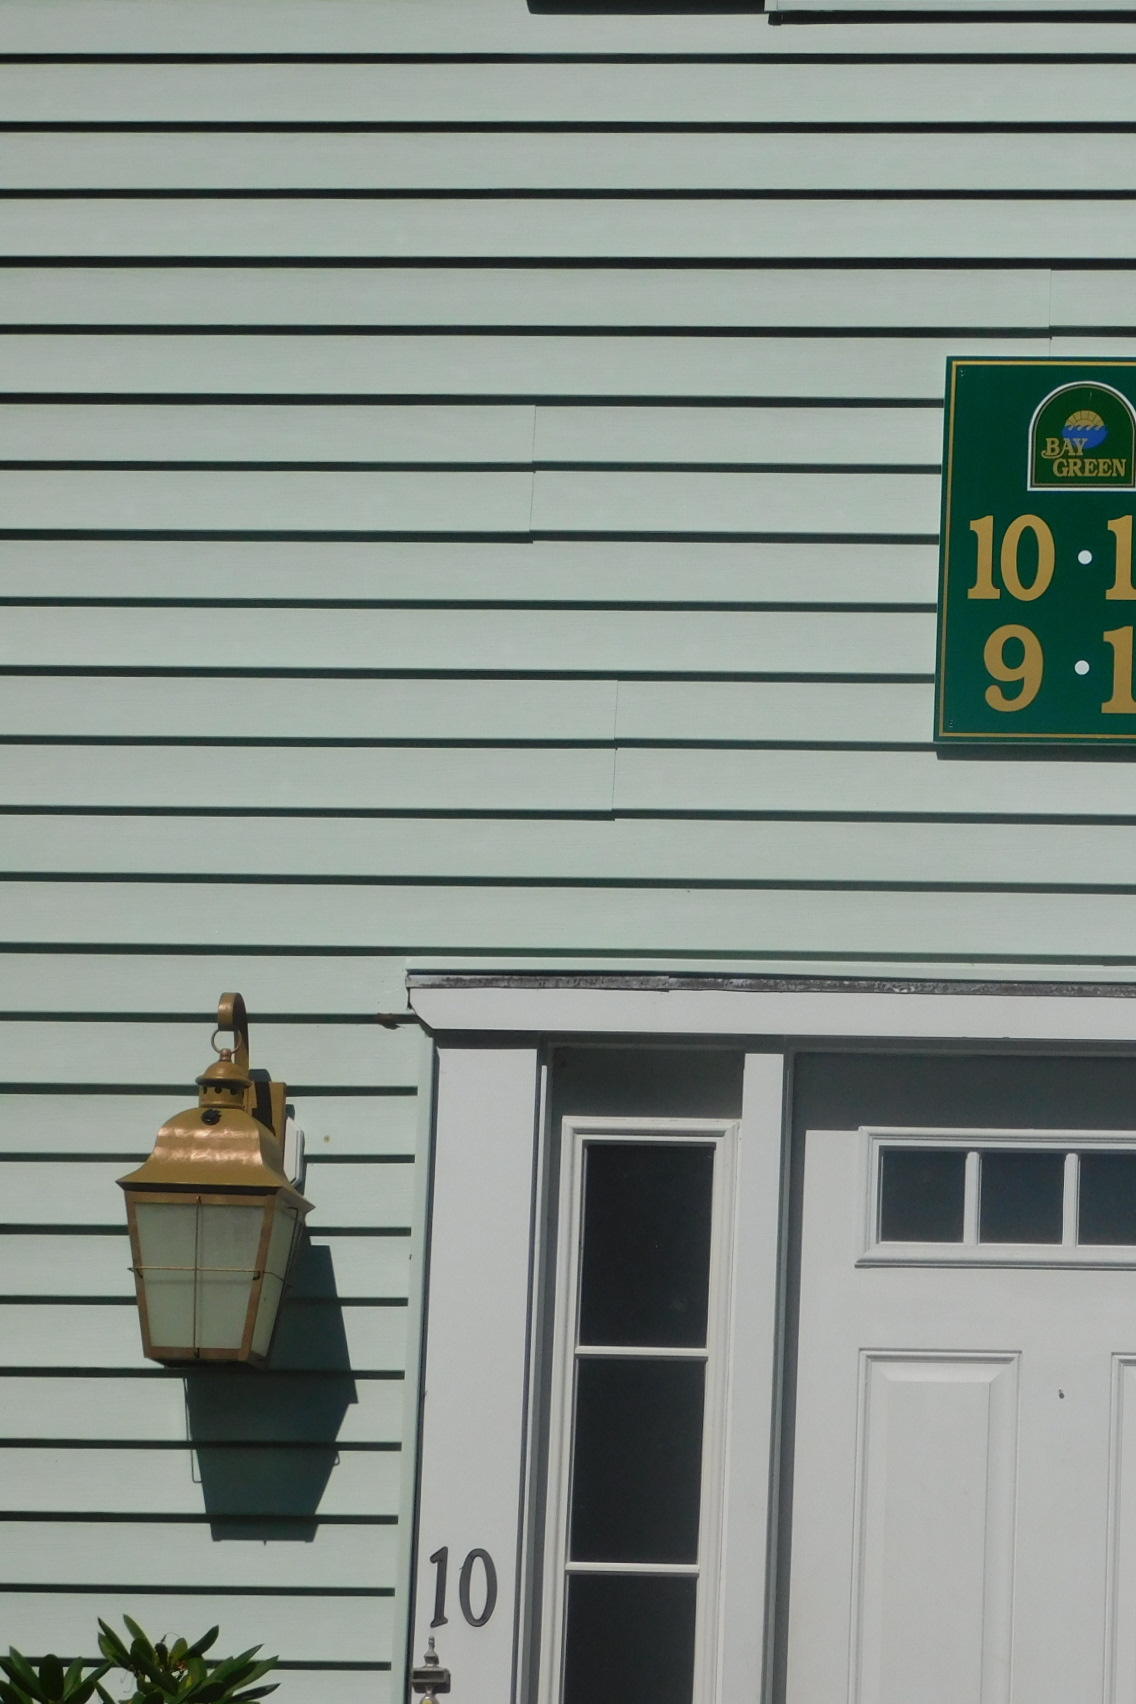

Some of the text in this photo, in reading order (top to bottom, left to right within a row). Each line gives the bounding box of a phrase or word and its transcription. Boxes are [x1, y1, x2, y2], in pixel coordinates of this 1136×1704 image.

[1041, 437, 1088, 459] BAY
[1052, 458, 1127, 477] GREEN
[967, 513, 1056, 602] 10
[983, 623, 1044, 713] 9
[429, 1545, 498, 1629] 10
